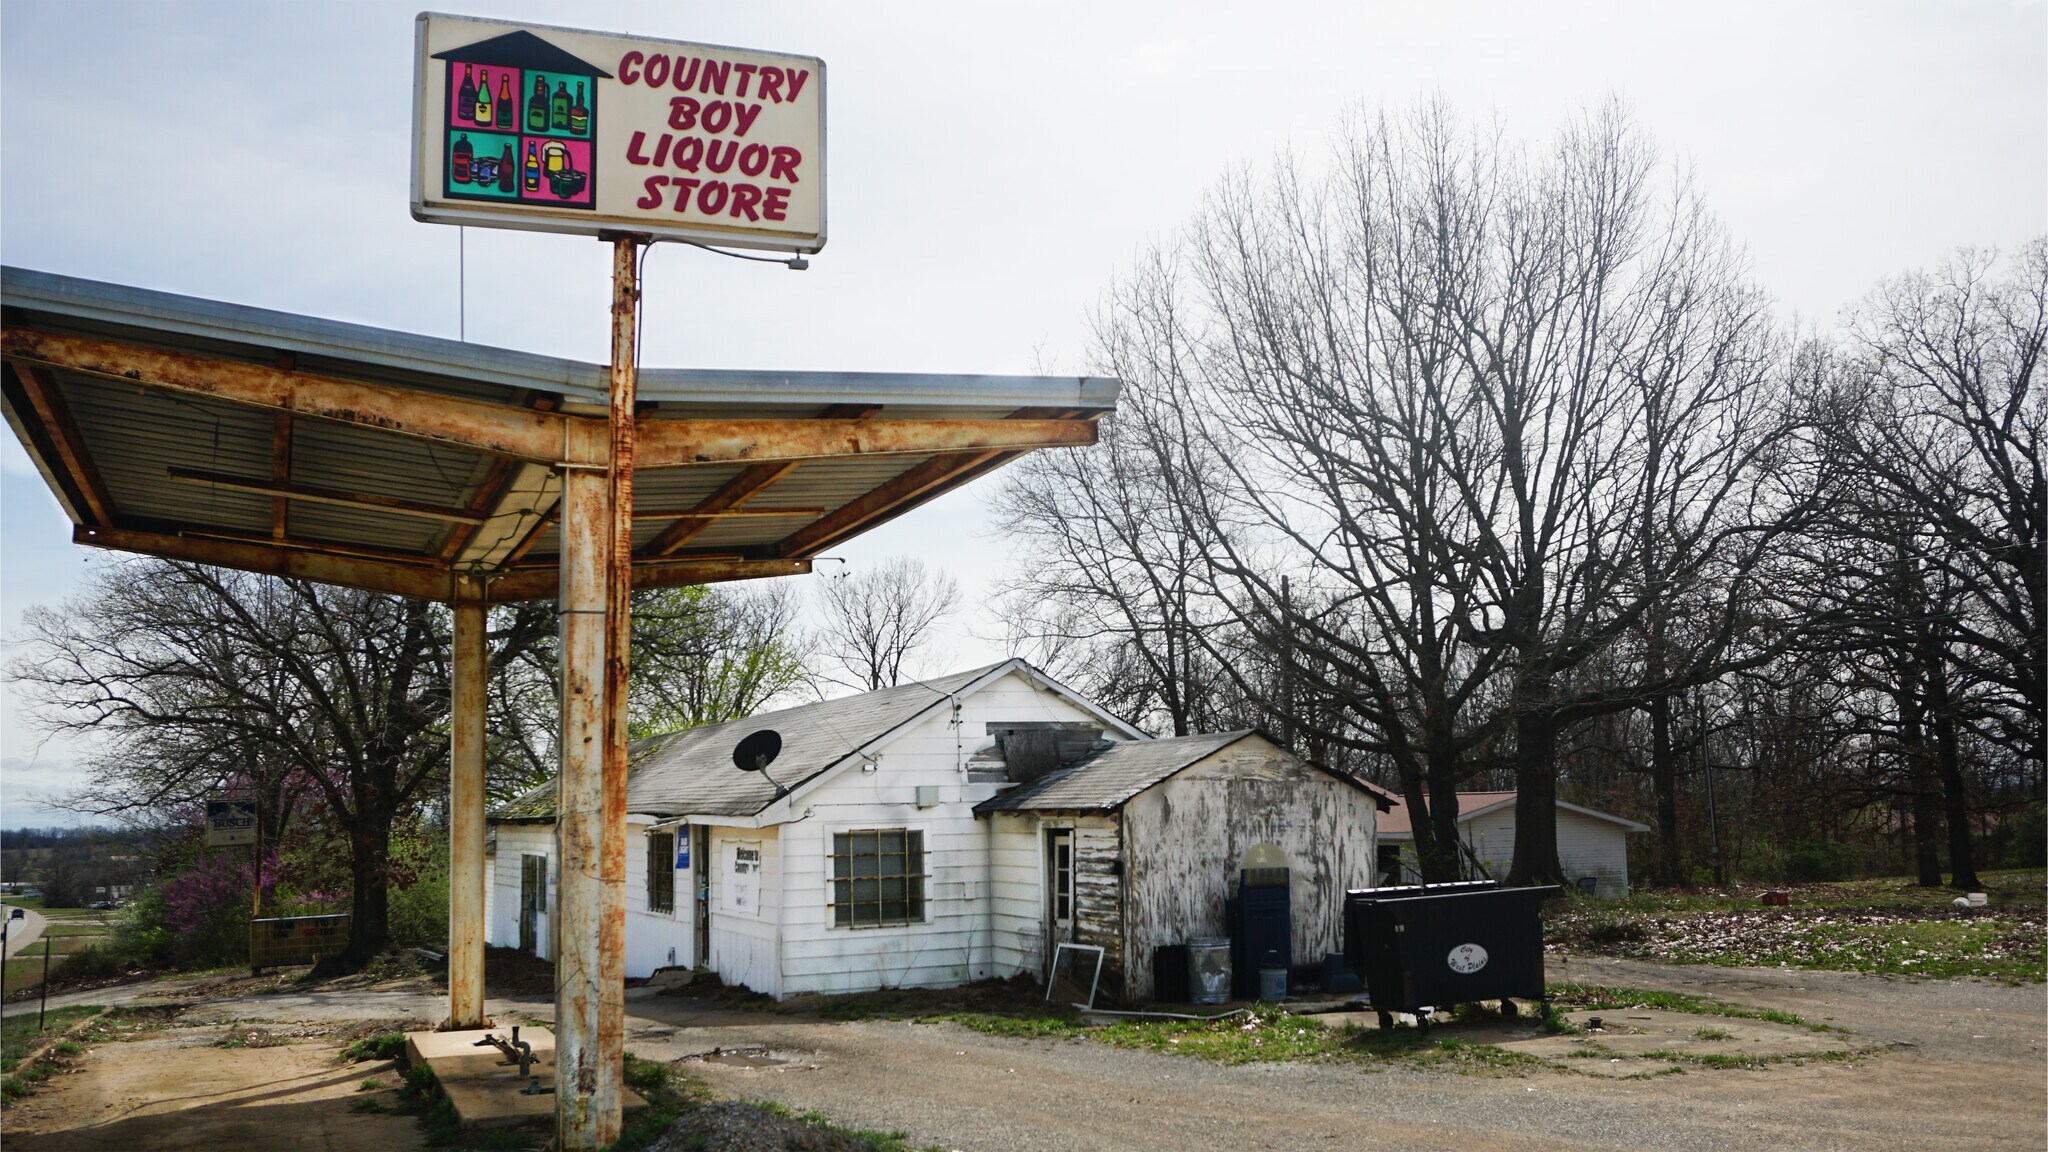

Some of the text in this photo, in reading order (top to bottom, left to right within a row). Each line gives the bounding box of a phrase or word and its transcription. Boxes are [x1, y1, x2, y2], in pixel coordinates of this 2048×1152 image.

[619, 50, 809, 104] COUNTRY
[668, 97, 762, 137] BOY
[626, 131, 802, 183] LIQUOR
[637, 175, 792, 222] STORE
[214, 817, 251, 828] BUSCH
[736, 846, 759, 862] Welcome to
[1460, 945, 1473, 954] City
[1450, 956, 1487, 972] West Plains
